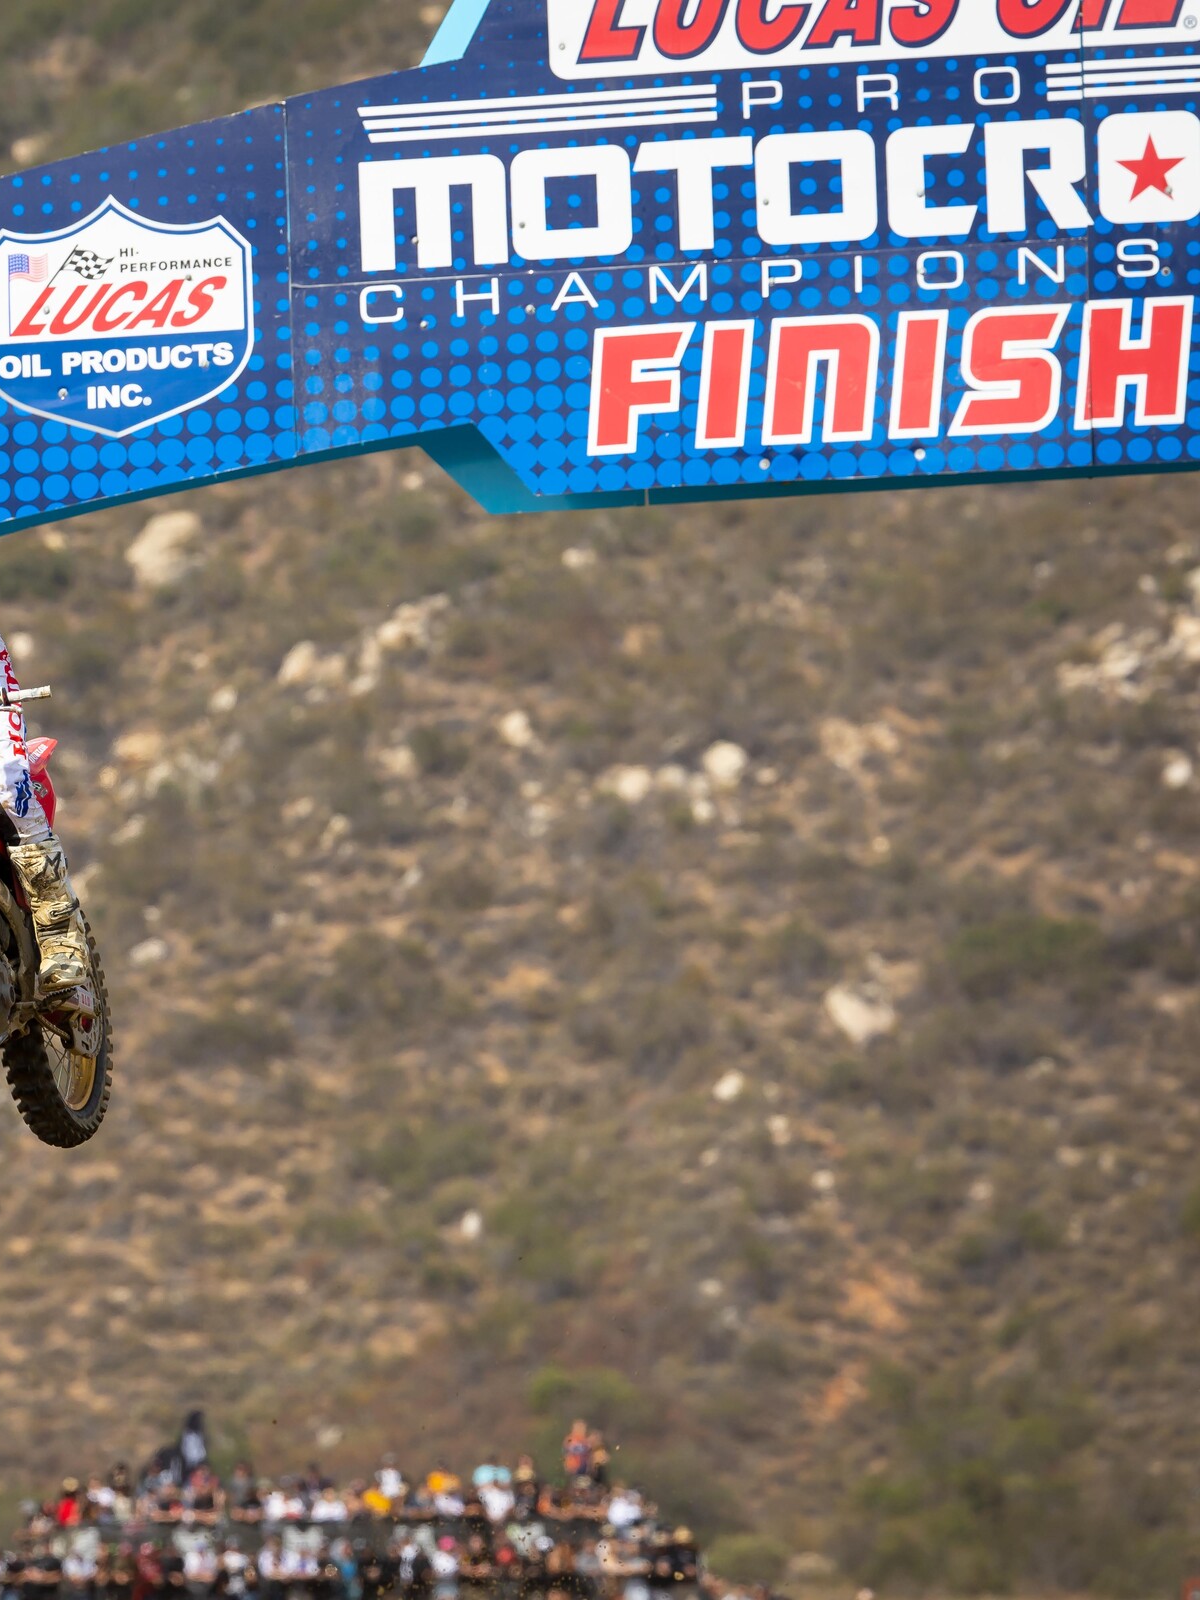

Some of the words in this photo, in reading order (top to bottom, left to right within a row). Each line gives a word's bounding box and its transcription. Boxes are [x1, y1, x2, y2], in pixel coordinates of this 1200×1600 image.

[742, 65, 1021, 119] PRO
[119, 248, 140, 258] HI-
[120, 257, 233, 273] PERFORMANCE
[359, 239, 1161, 325] CHAMPIONS
[10, 276, 228, 336] LUCAS
[62, 342, 234, 375] PRODUCTS
[587, 295, 1195, 457] FINISH
[86, 384, 152, 410] INC.
